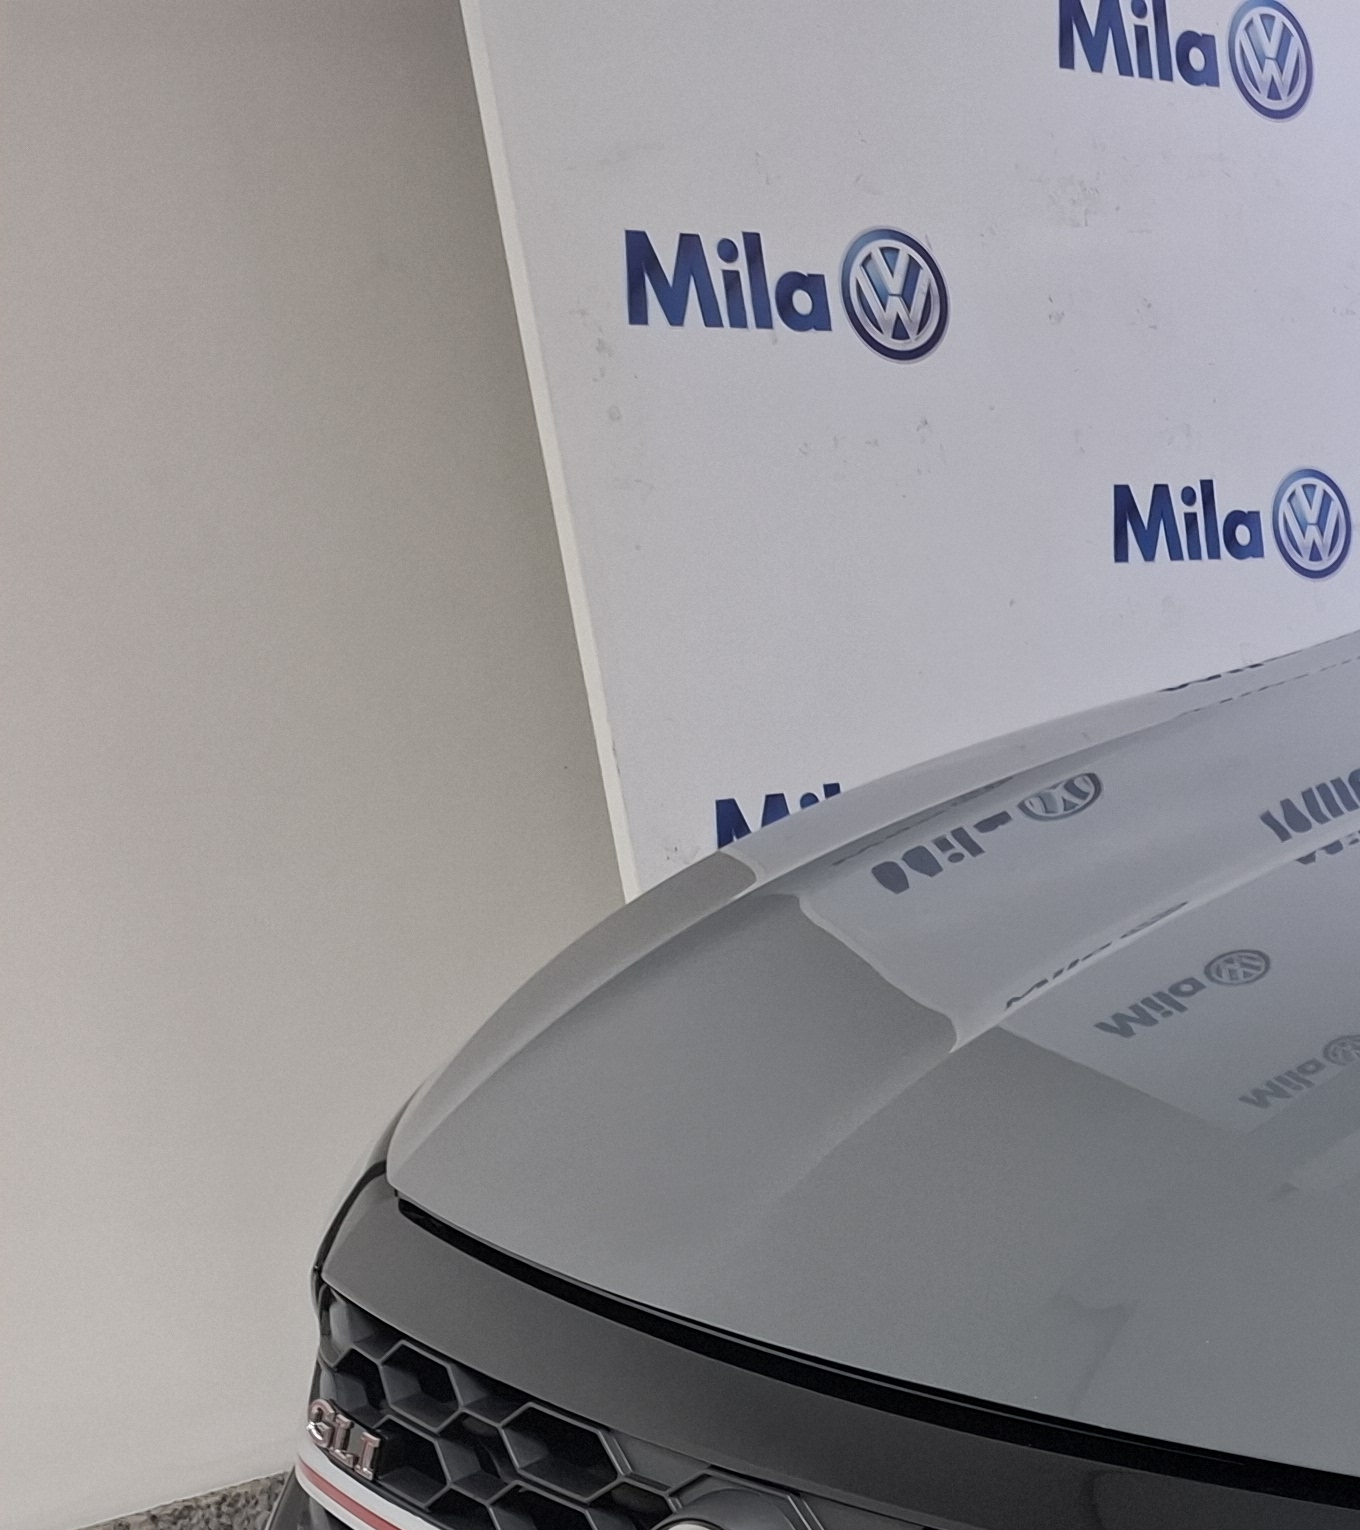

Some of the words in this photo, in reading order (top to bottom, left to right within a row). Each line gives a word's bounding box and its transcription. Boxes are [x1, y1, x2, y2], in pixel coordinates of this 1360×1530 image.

[1059, 0, 1219, 88] Mila
[625, 230, 832, 332] Mila
[1114, 479, 1264, 563] Mila
